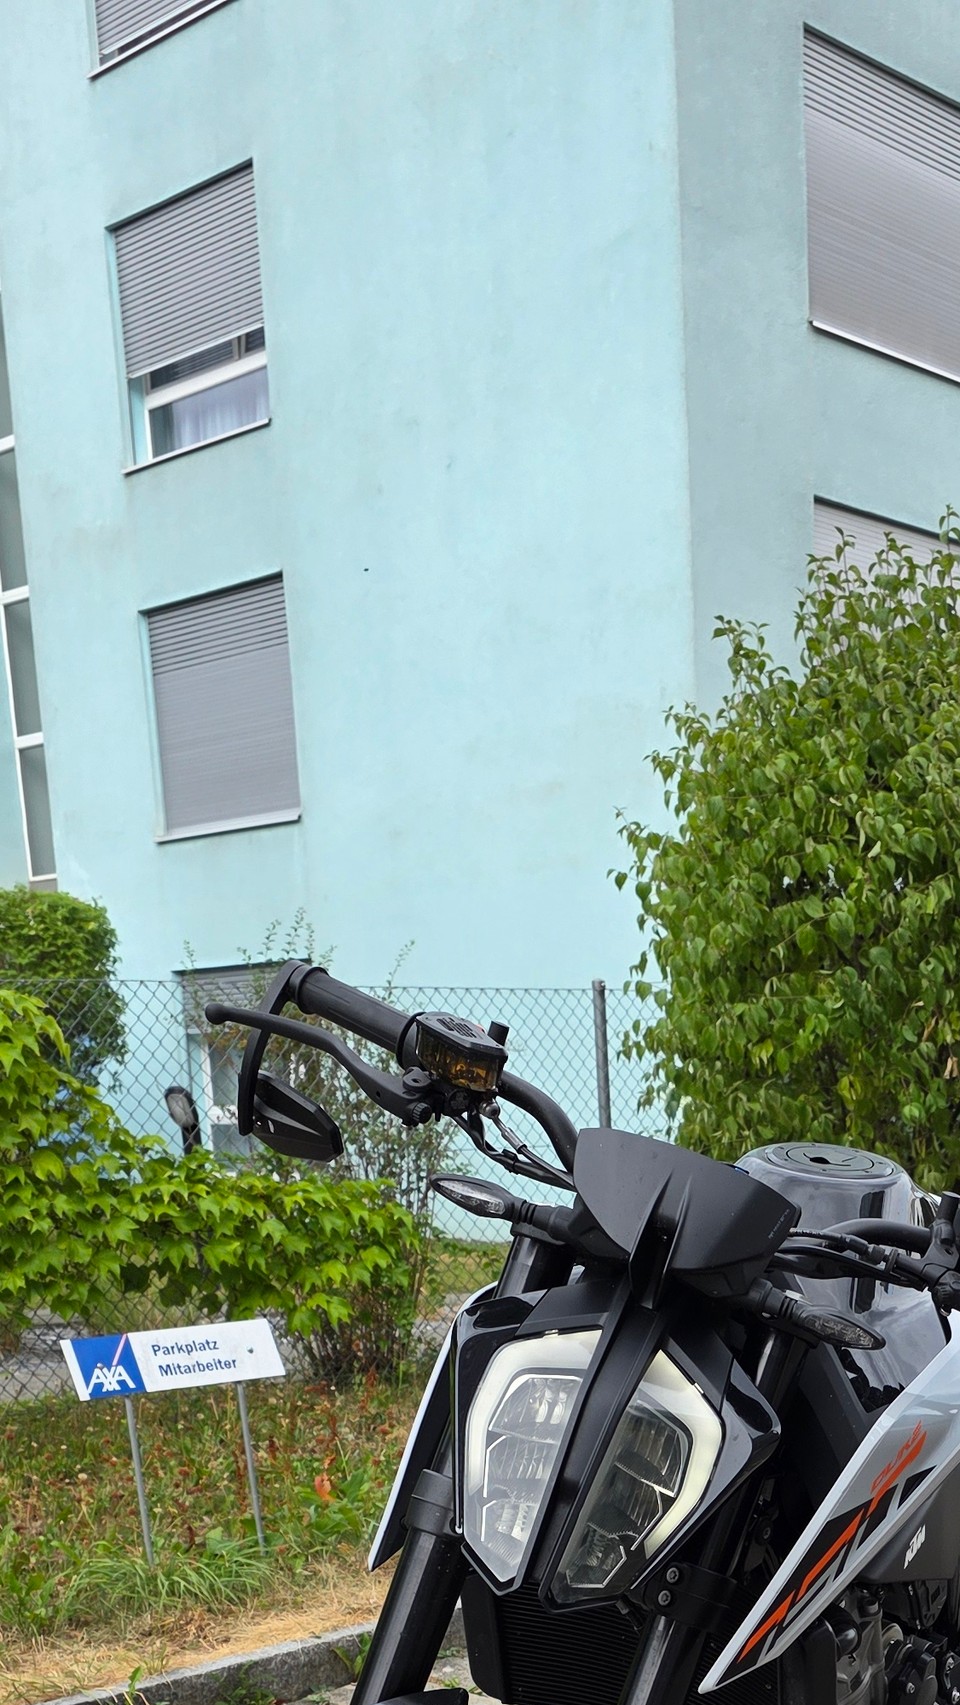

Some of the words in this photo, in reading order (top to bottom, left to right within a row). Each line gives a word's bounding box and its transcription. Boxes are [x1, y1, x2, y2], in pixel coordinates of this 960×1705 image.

[151, 1338, 219, 1358] Parkplatz
[87, 1365, 136, 1394] AXA
[158, 1357, 238, 1378] Mitarbeiter
[870, 1419, 922, 1494] DUKE
[903, 1524, 926, 1569] KTM
